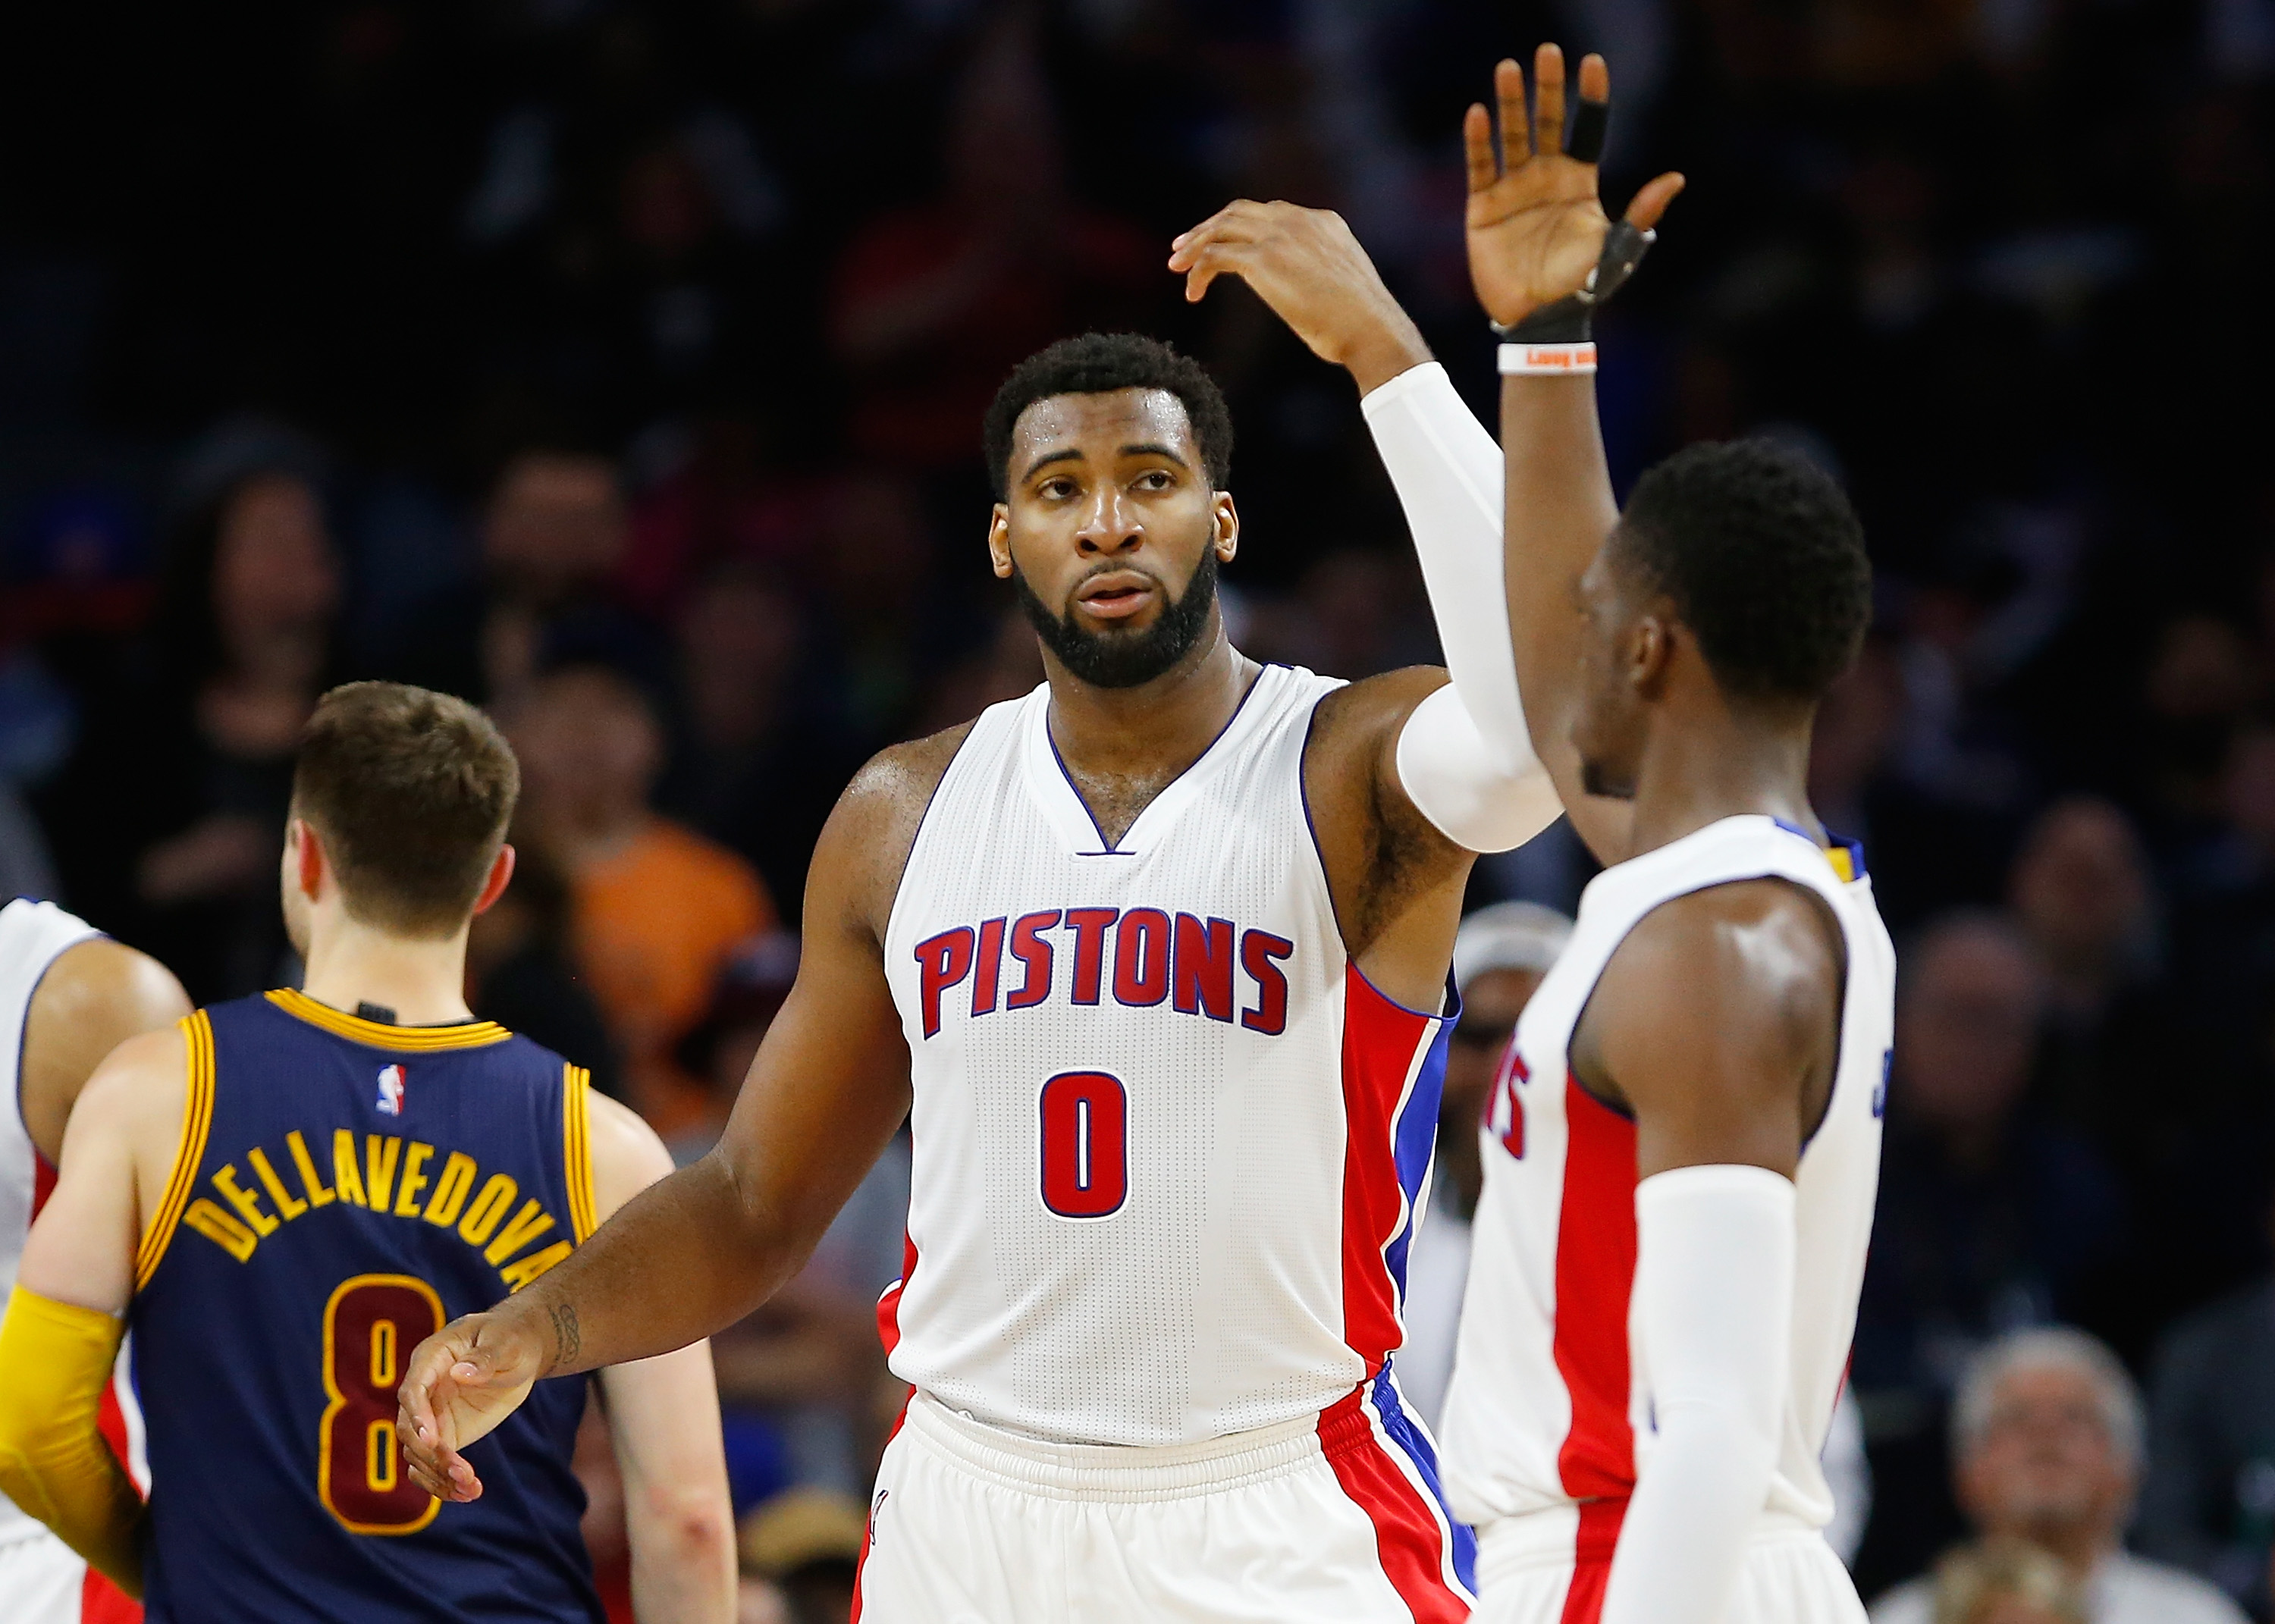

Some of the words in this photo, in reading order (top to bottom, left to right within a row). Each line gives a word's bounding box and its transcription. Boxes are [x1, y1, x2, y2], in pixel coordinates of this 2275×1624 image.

[914, 907, 1294, 1041] PISTONS
[182, 1128, 575, 1294] DELLAVEDOVA
[1040, 1070, 1128, 1219] 0
[318, 1272, 446, 1536] 8
